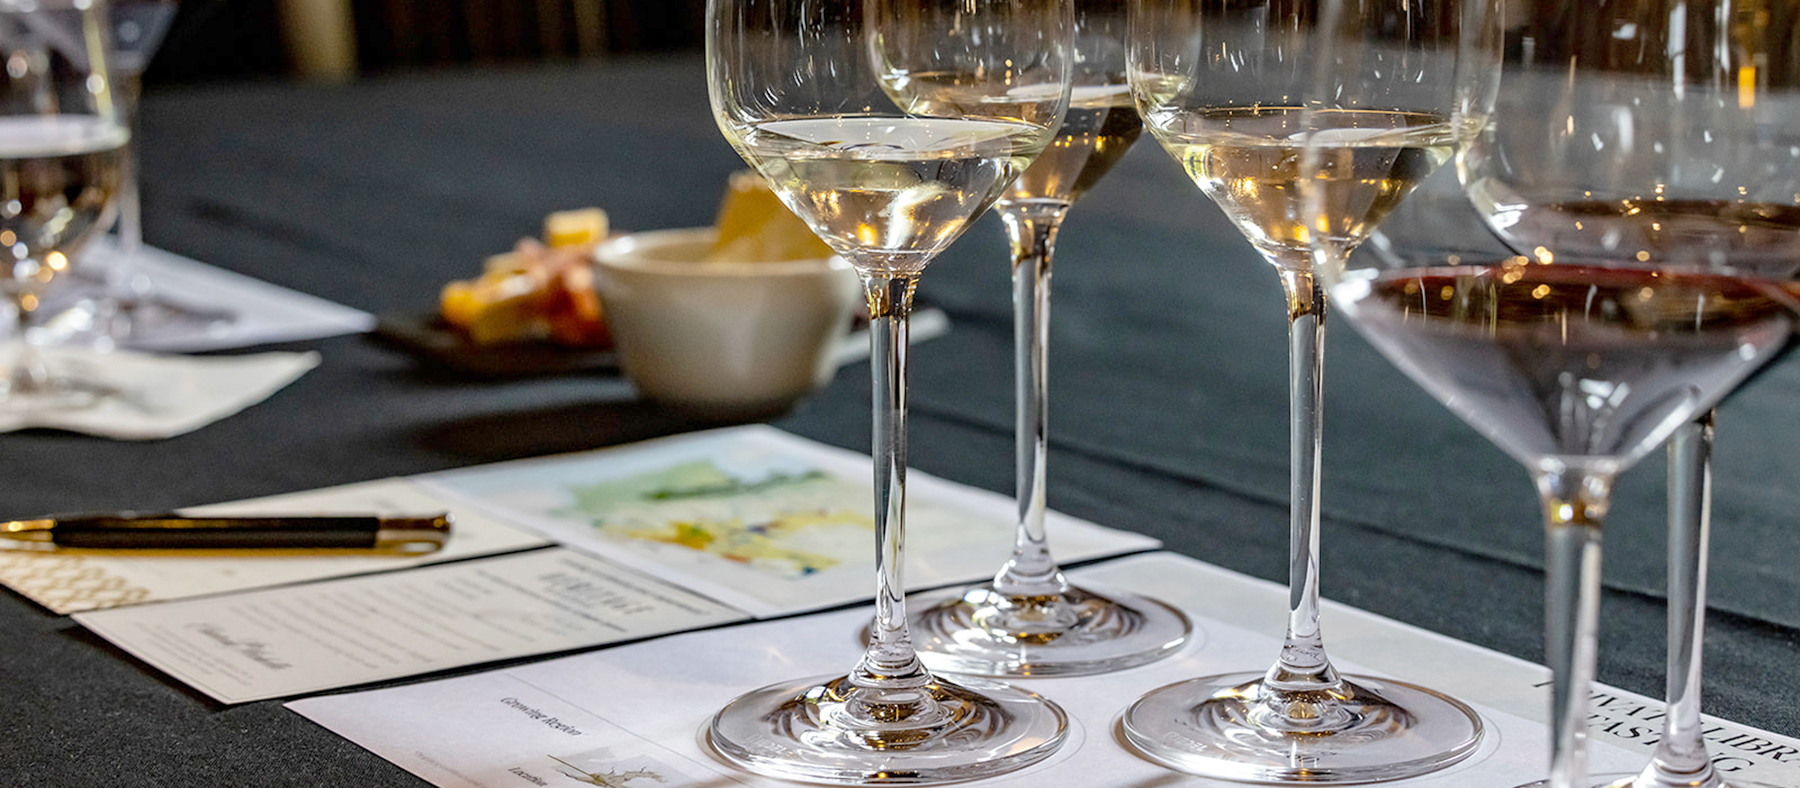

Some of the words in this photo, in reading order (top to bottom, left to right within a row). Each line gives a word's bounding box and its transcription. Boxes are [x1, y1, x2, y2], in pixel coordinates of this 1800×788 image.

[541, 717, 582, 736] Region
[1701, 726, 1800, 768] LIBR
[507, 767, 548, 787] Location
